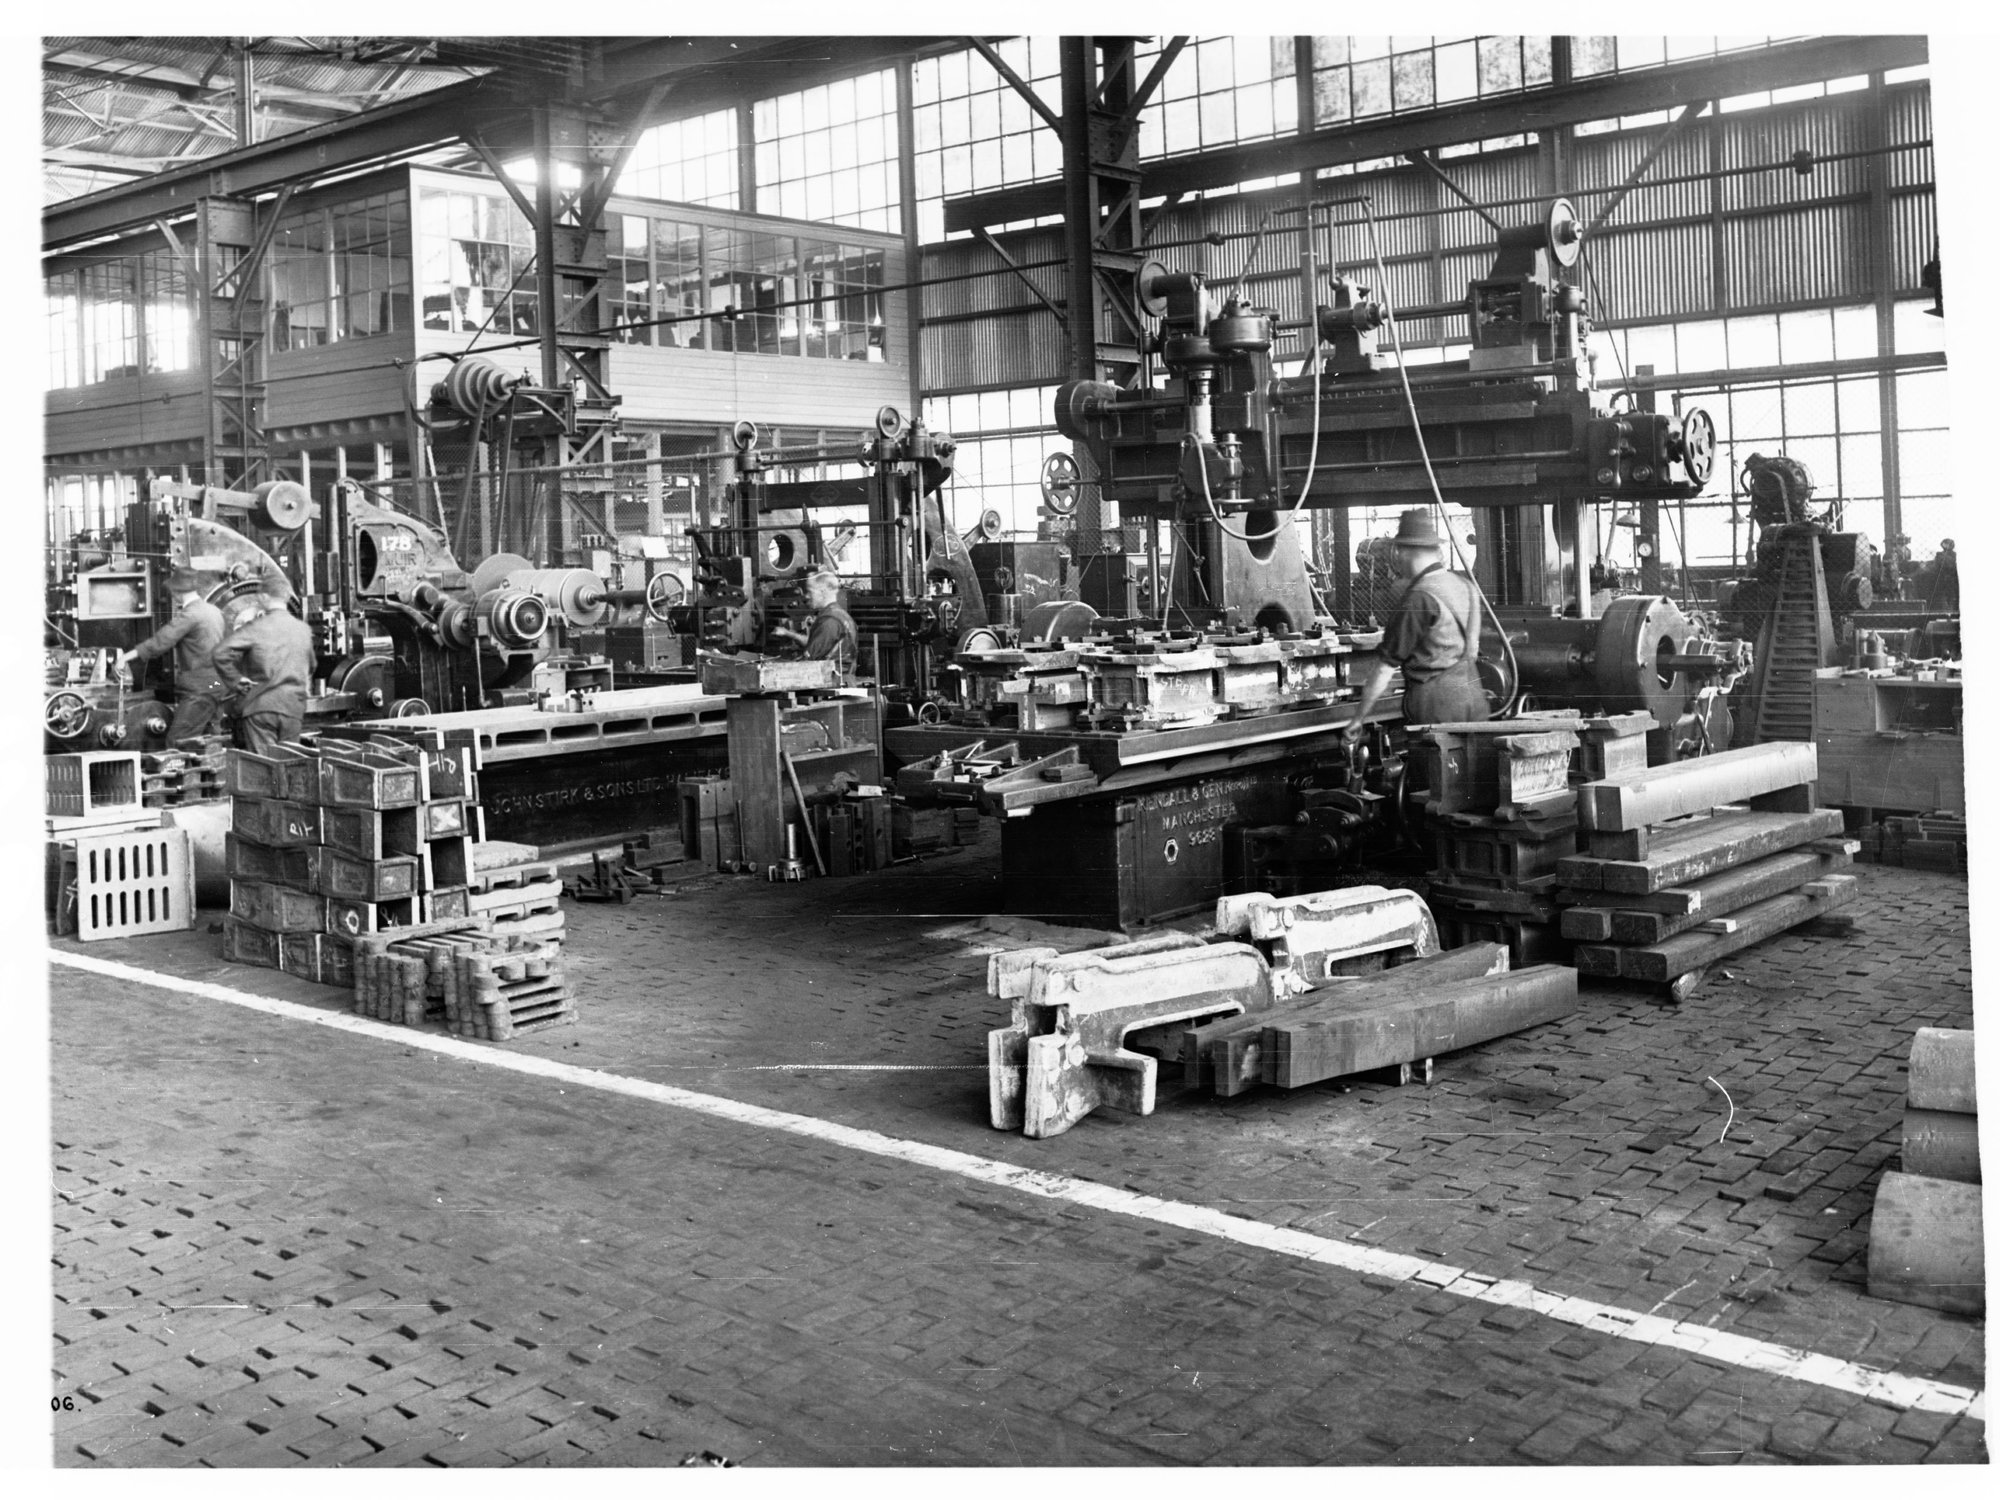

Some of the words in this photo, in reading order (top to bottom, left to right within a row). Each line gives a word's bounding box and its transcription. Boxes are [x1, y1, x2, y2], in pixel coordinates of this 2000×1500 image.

[381, 535, 412, 552] 178
[490, 793, 533, 815] JOHN
[535, 788, 580, 809] STIRK
[583, 787, 594, 801] &
[596, 780, 634, 799] SONS
[1162, 801, 1238, 830] MANCHESTER
